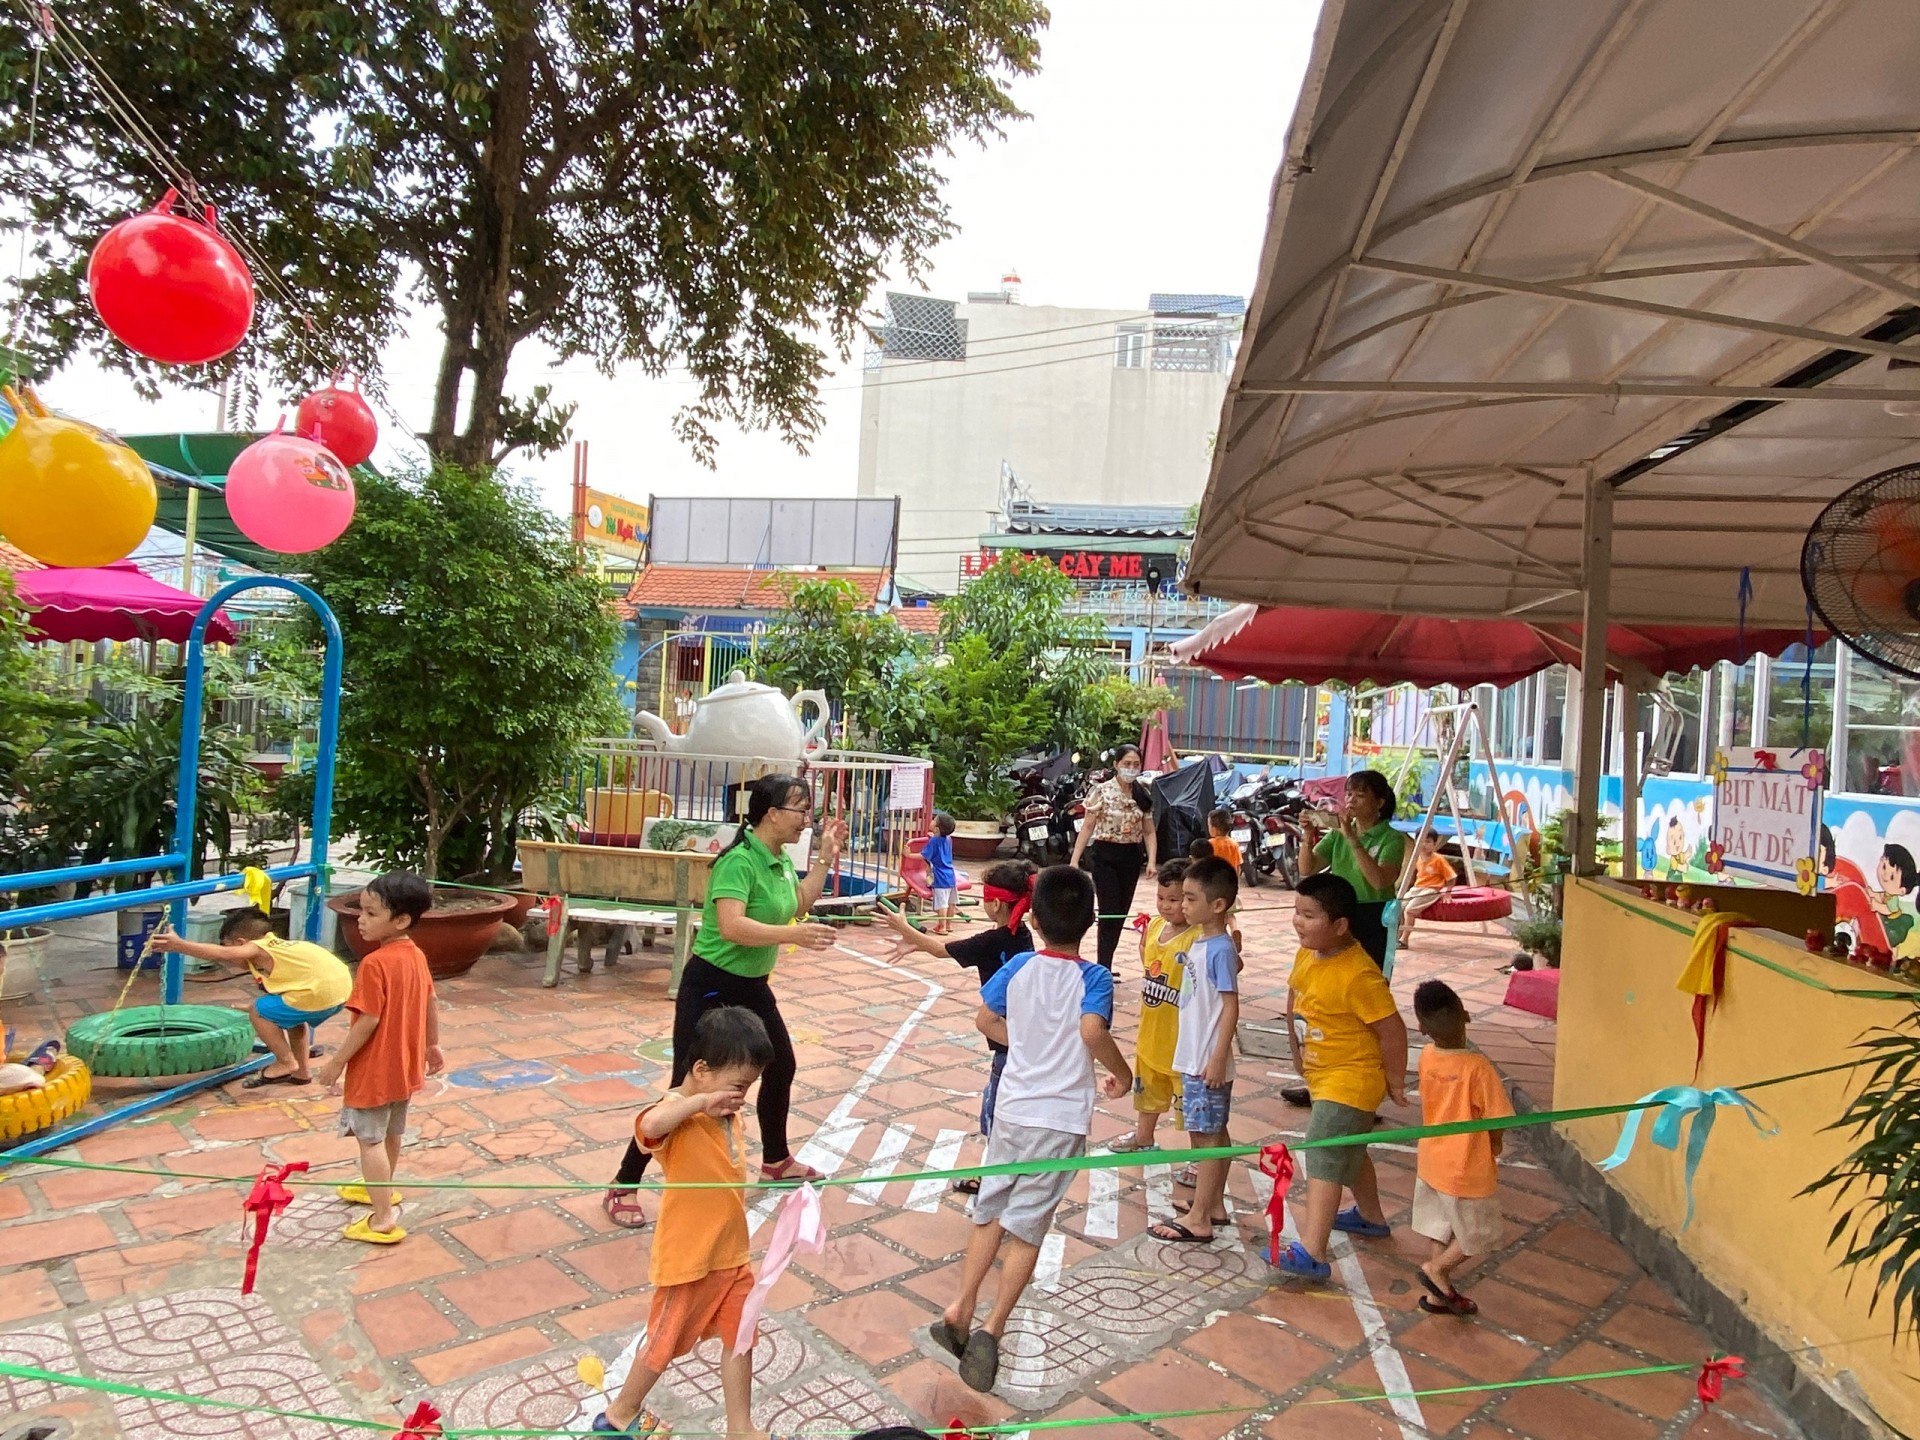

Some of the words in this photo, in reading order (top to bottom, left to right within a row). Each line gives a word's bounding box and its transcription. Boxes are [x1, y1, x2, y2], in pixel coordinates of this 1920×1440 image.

[1059, 551, 1104, 578] CÂY
[1721, 779, 1754, 814] BỊT
[1760, 775, 1808, 815] MẮT
[1722, 821, 1761, 860] BẮT
[1764, 828, 1795, 867] DÊ
